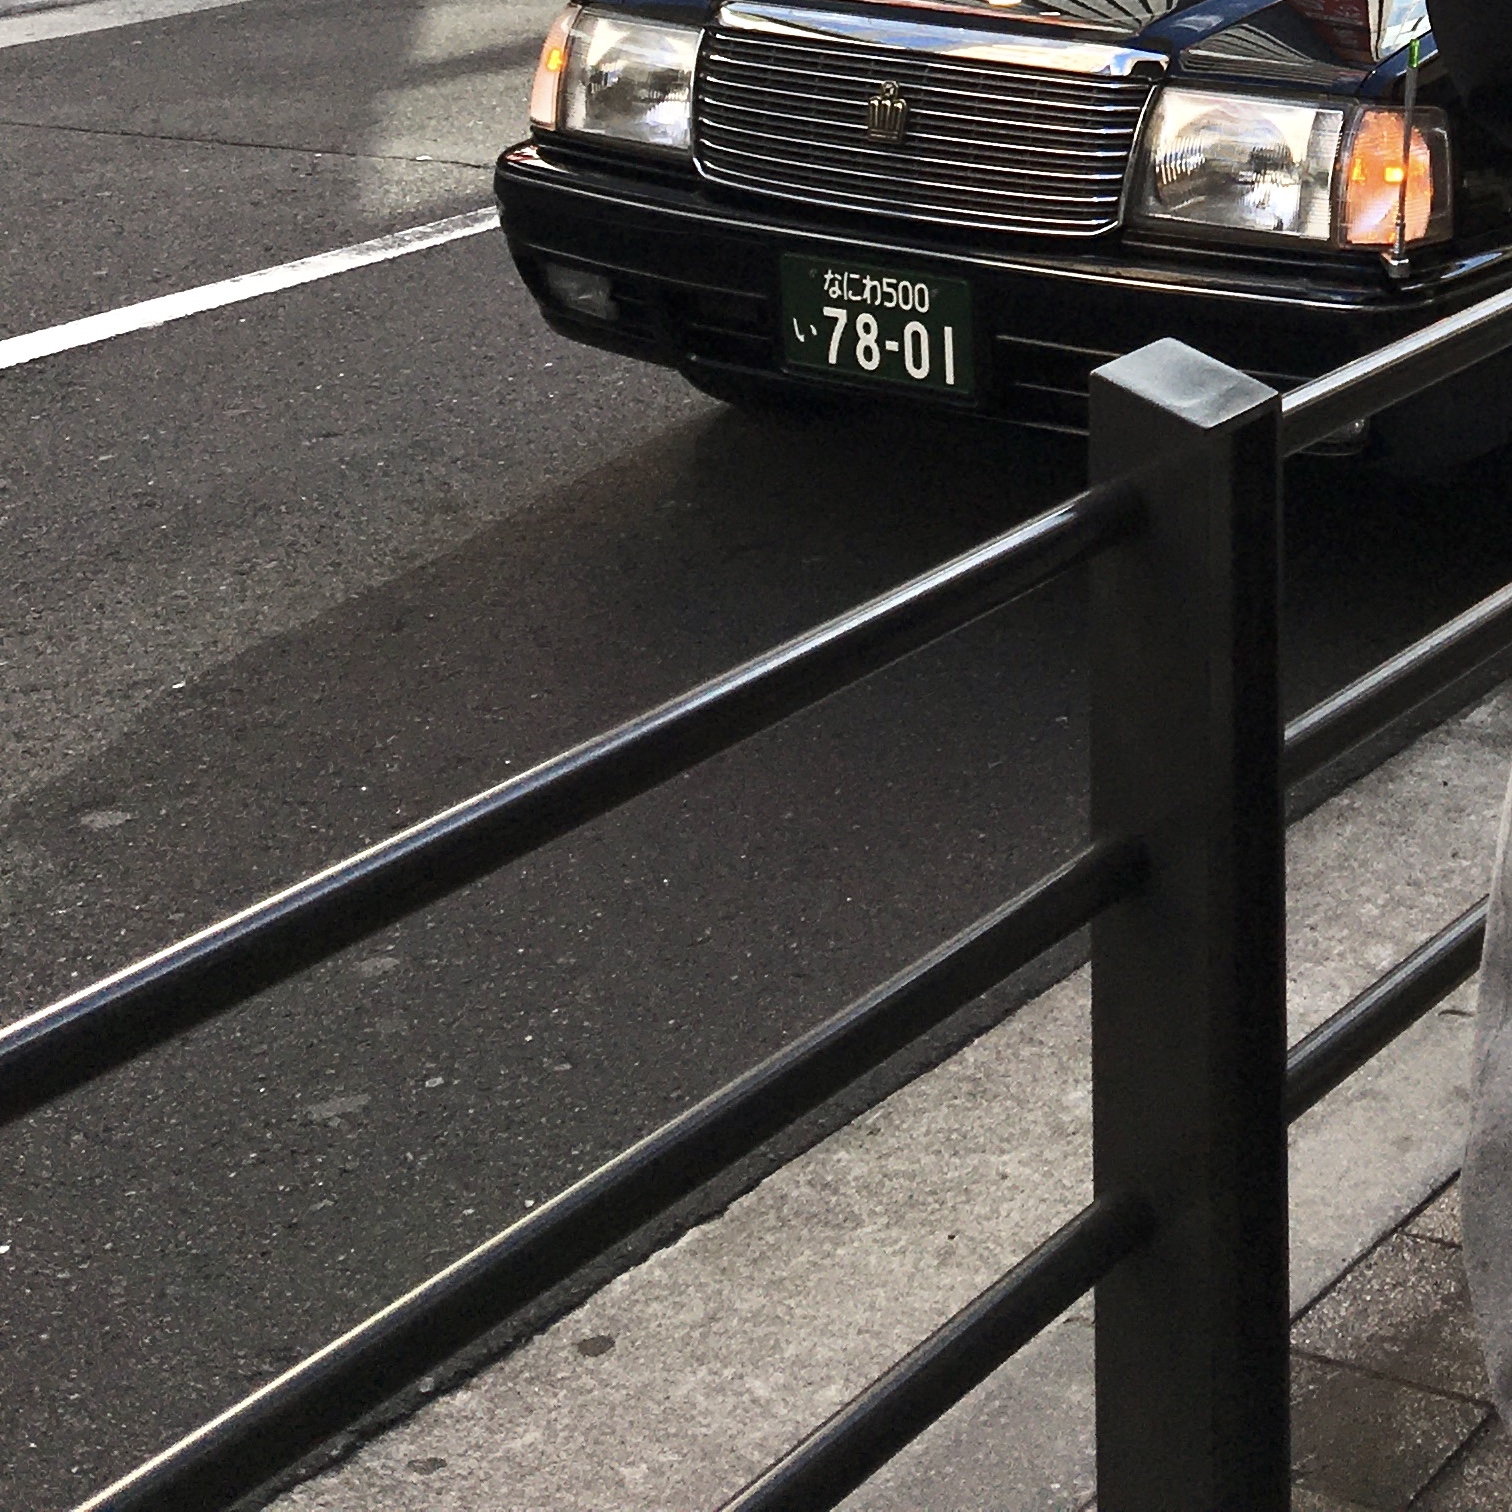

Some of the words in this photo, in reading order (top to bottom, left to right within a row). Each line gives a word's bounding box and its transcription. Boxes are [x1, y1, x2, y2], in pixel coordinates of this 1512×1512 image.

[823, 268, 930, 313] なにわ500
[792, 317, 817, 343] い
[823, 306, 955, 385] 78-01
